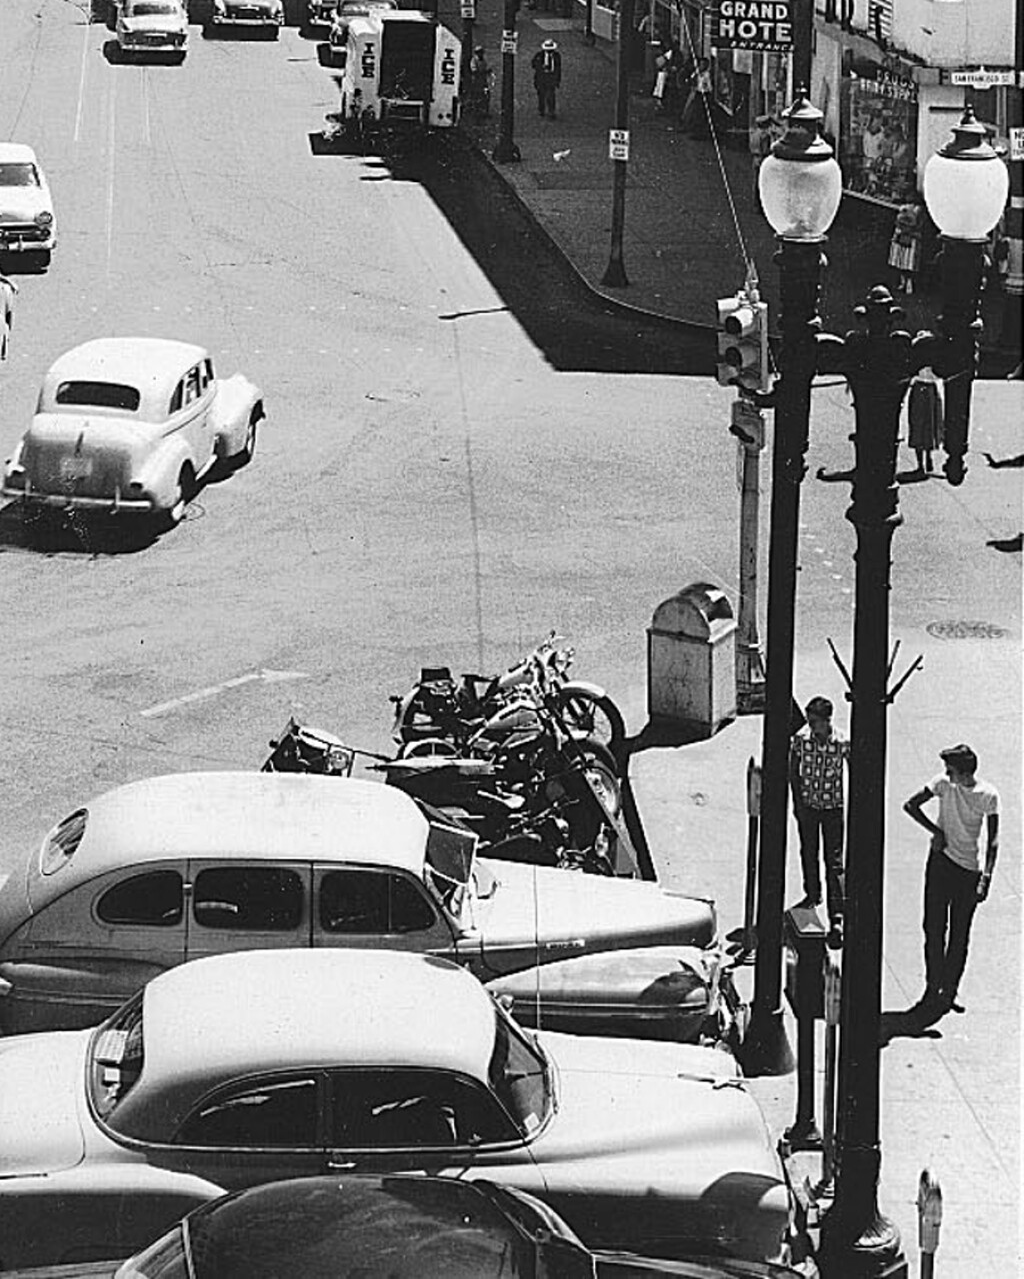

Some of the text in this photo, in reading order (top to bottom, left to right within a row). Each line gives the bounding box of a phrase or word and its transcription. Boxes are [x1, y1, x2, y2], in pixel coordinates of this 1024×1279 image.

[720, 0, 789, 20] GRAND
[718, 19, 793, 42] HOTE
[361, 42, 375, 78] ICE
[441, 48, 455, 85] ICE
